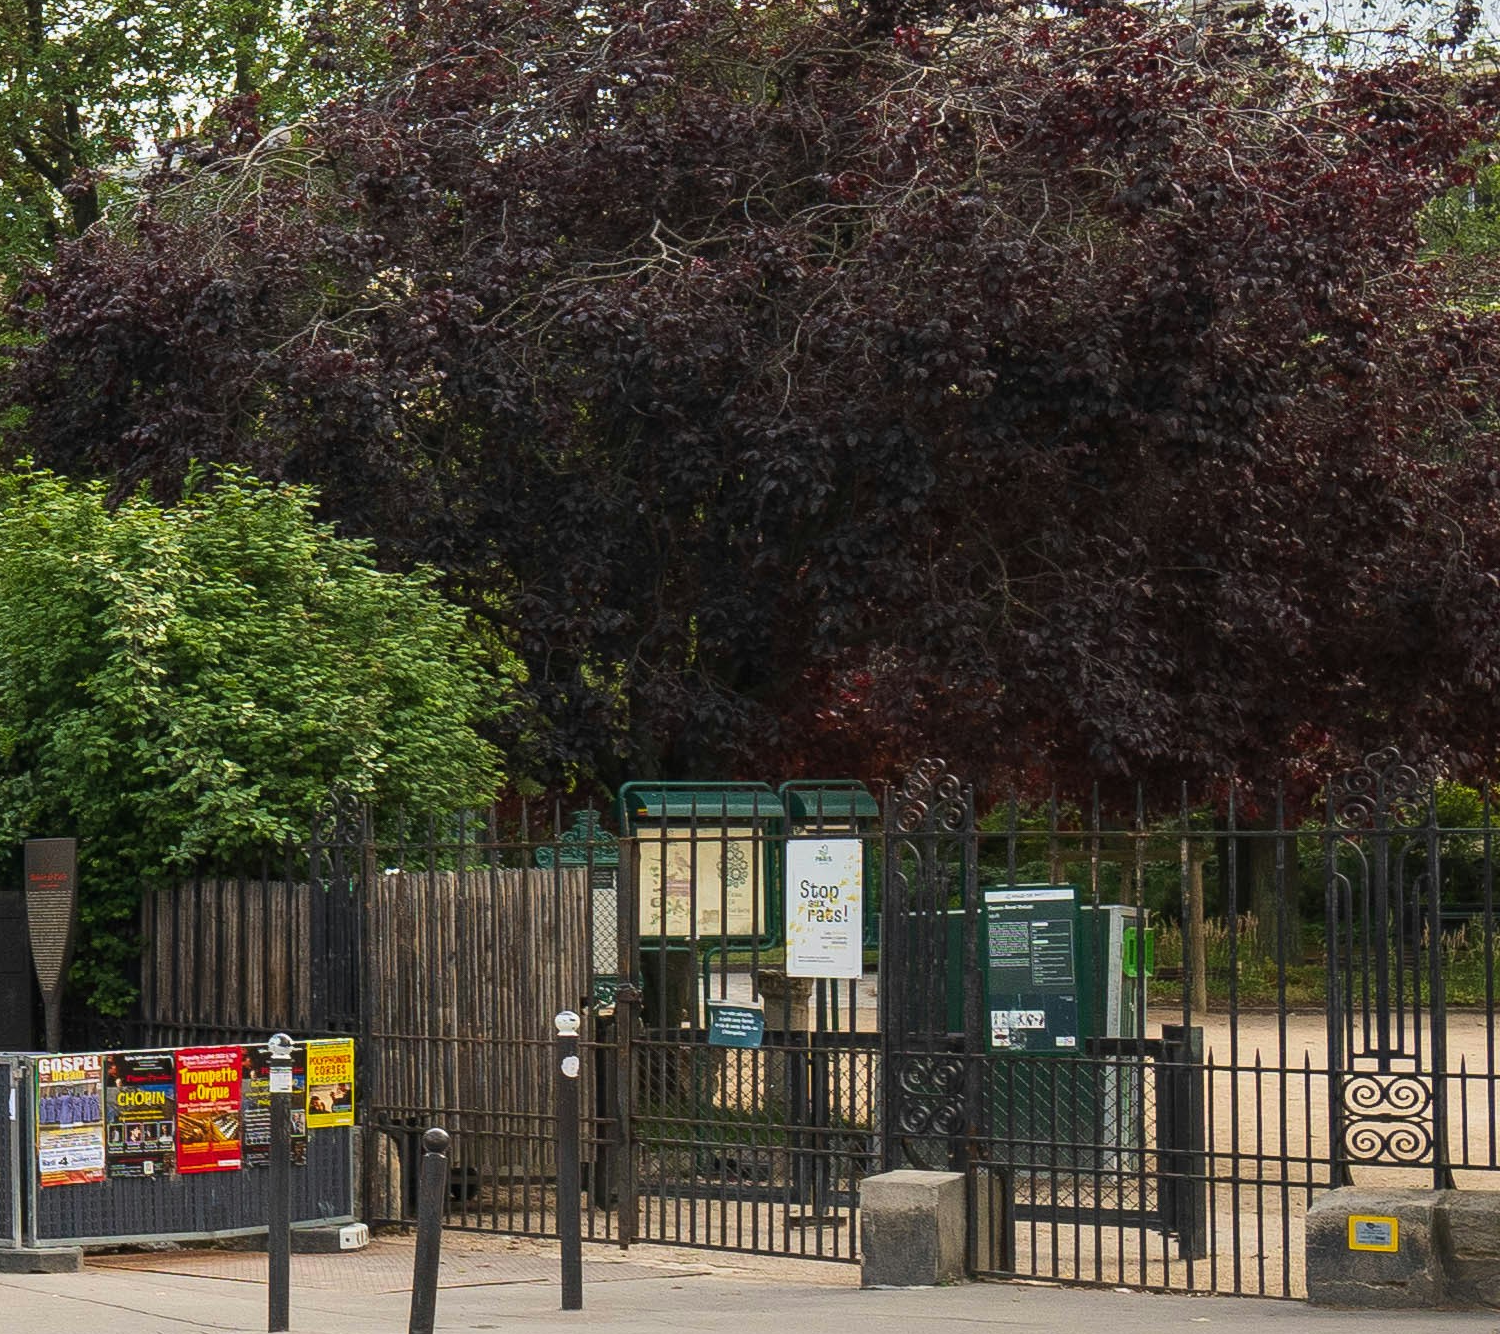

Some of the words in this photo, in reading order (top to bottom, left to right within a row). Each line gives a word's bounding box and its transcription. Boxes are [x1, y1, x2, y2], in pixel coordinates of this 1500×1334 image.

[800, 879, 840, 904] Stop
[807, 905, 849, 923] rats!
[38, 1055, 102, 1075] GOSPEL
[314, 1065, 347, 1076] CORSES
[179, 1067, 239, 1087] Trompette
[116, 1091, 166, 1107] CHOPIN
[197, 1085, 230, 1103] Orgue
